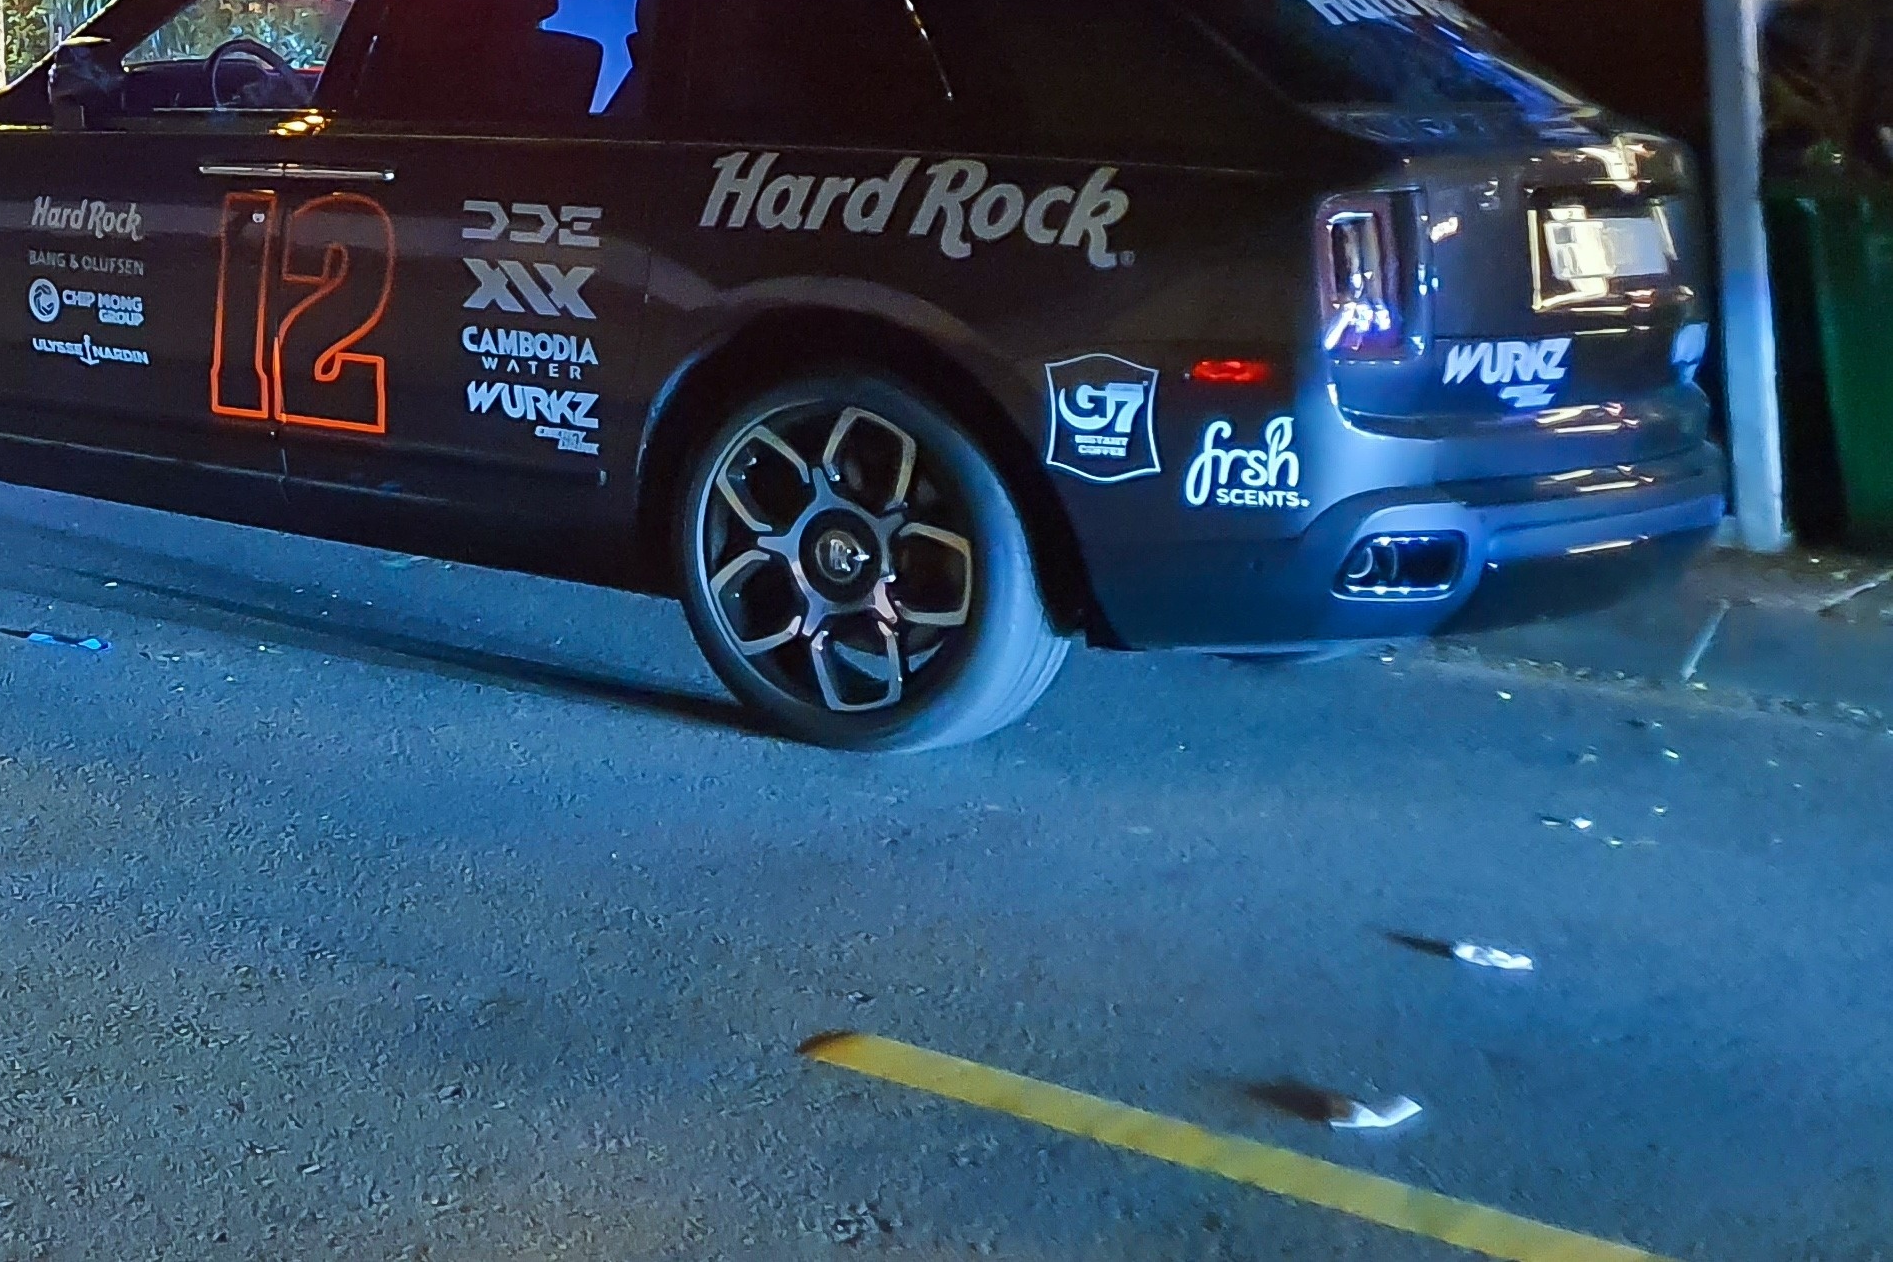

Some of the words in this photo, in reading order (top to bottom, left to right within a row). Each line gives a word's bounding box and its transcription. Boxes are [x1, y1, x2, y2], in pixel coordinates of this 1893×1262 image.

[30, 195, 88, 230] Hard
[87, 200, 143, 242] Rock
[698, 150, 922, 234] Hard
[908, 157, 1131, 269] Rock
[28, 249, 66, 269] BANG
[69, 253, 80, 270] &
[81, 255, 144, 276] OLUFSEN
[97, 292, 143, 312] MONG
[98, 308, 145, 326] GROUP
[209, 190, 395, 434] 12
[461, 325, 599, 365] CAMBODIA
[481, 355, 582, 380] WATER
[466, 380, 600, 429] WURKZ
[1058, 382, 1145, 434] G7
[1185, 415, 1300, 506] frsh
